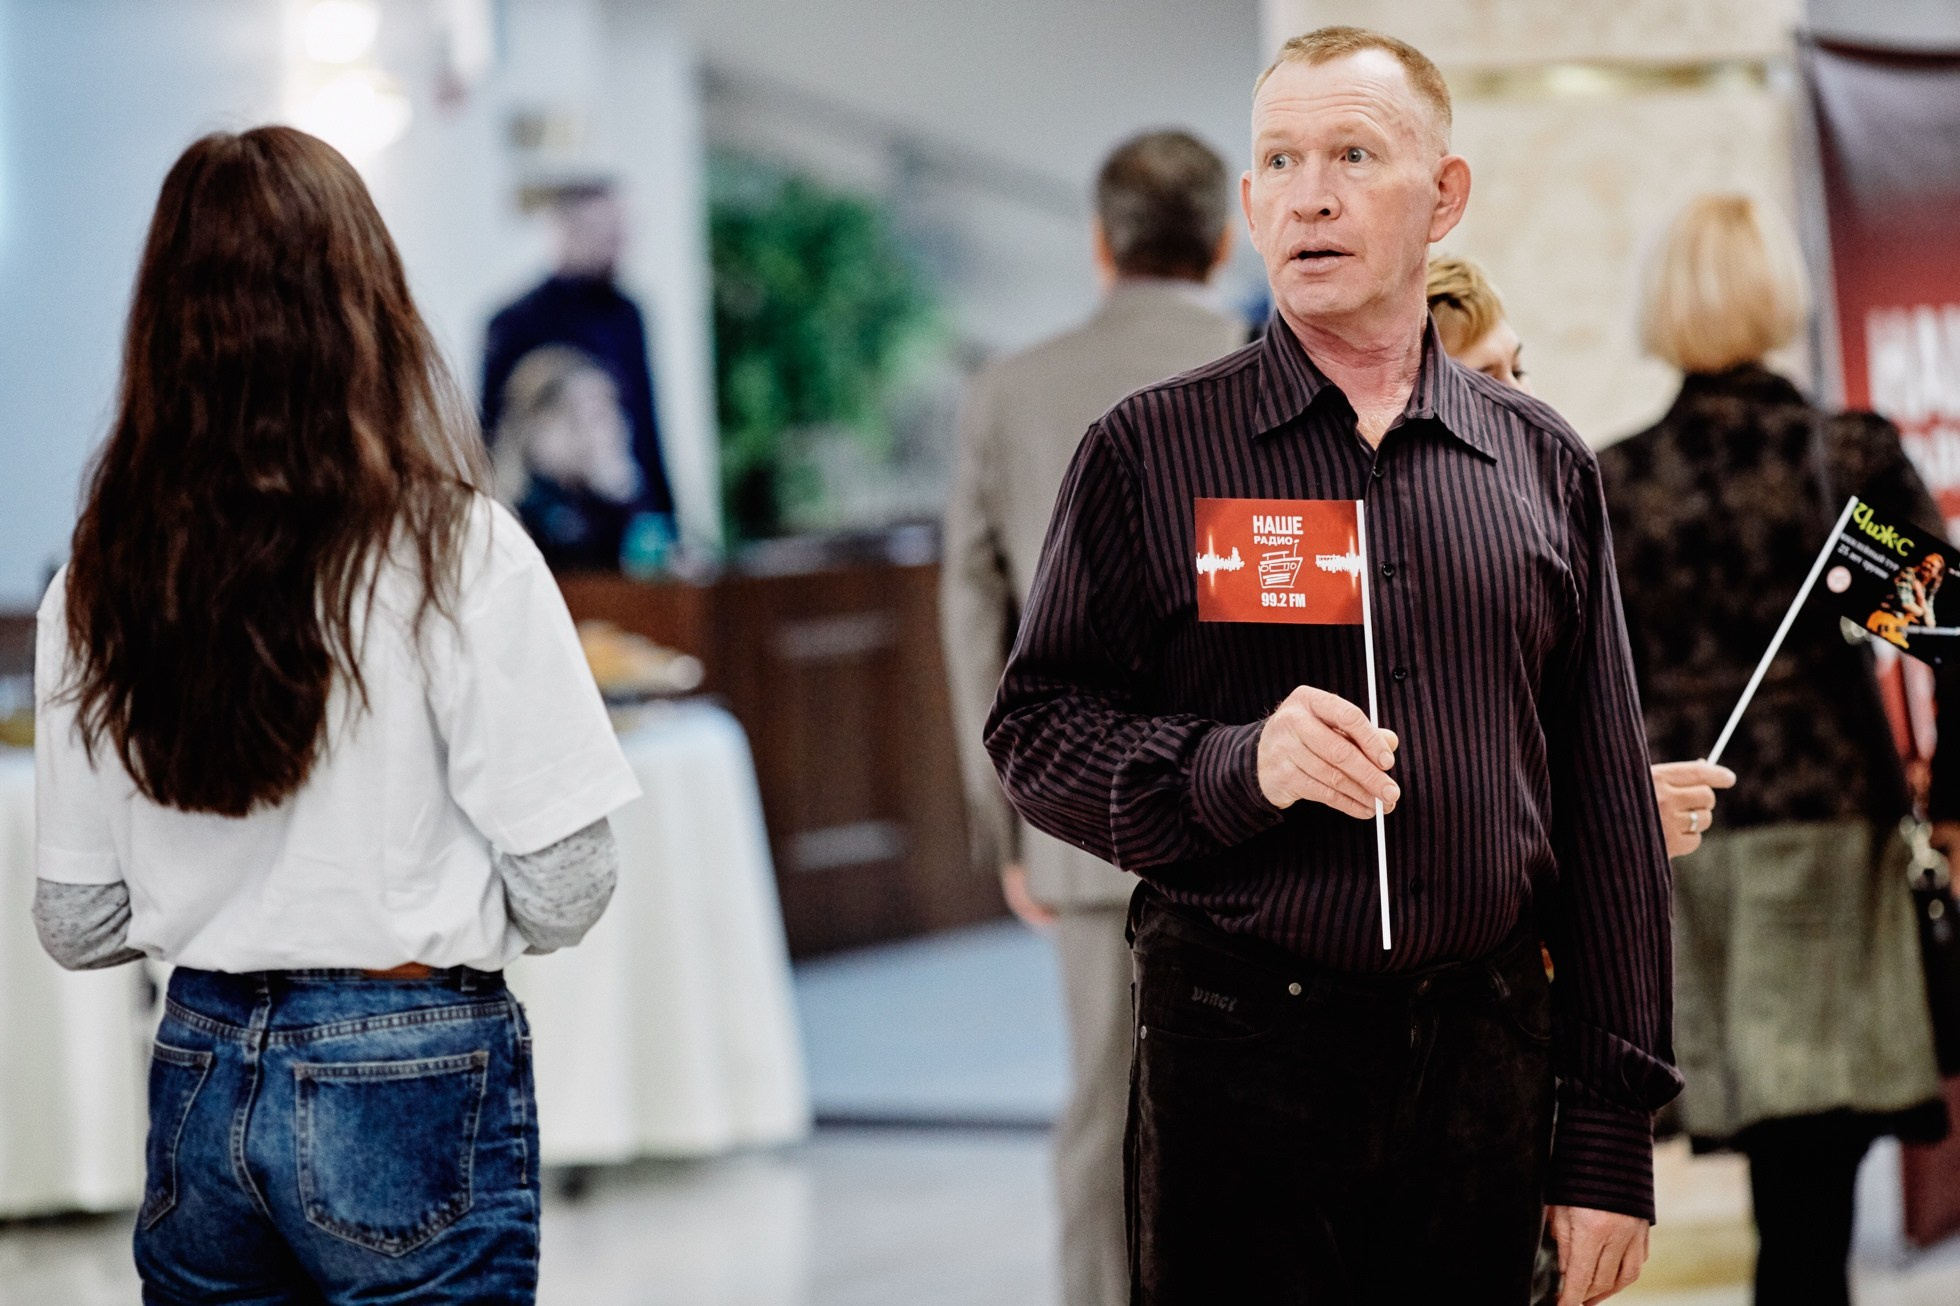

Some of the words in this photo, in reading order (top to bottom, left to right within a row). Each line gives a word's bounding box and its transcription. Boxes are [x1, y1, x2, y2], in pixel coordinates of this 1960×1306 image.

[1252, 515, 1304, 535] НАШЕ
[1253, 535, 1294, 546] РАДИО
[1261, 592, 1288, 607] 99.2
[1289, 593, 1306, 608] FM
